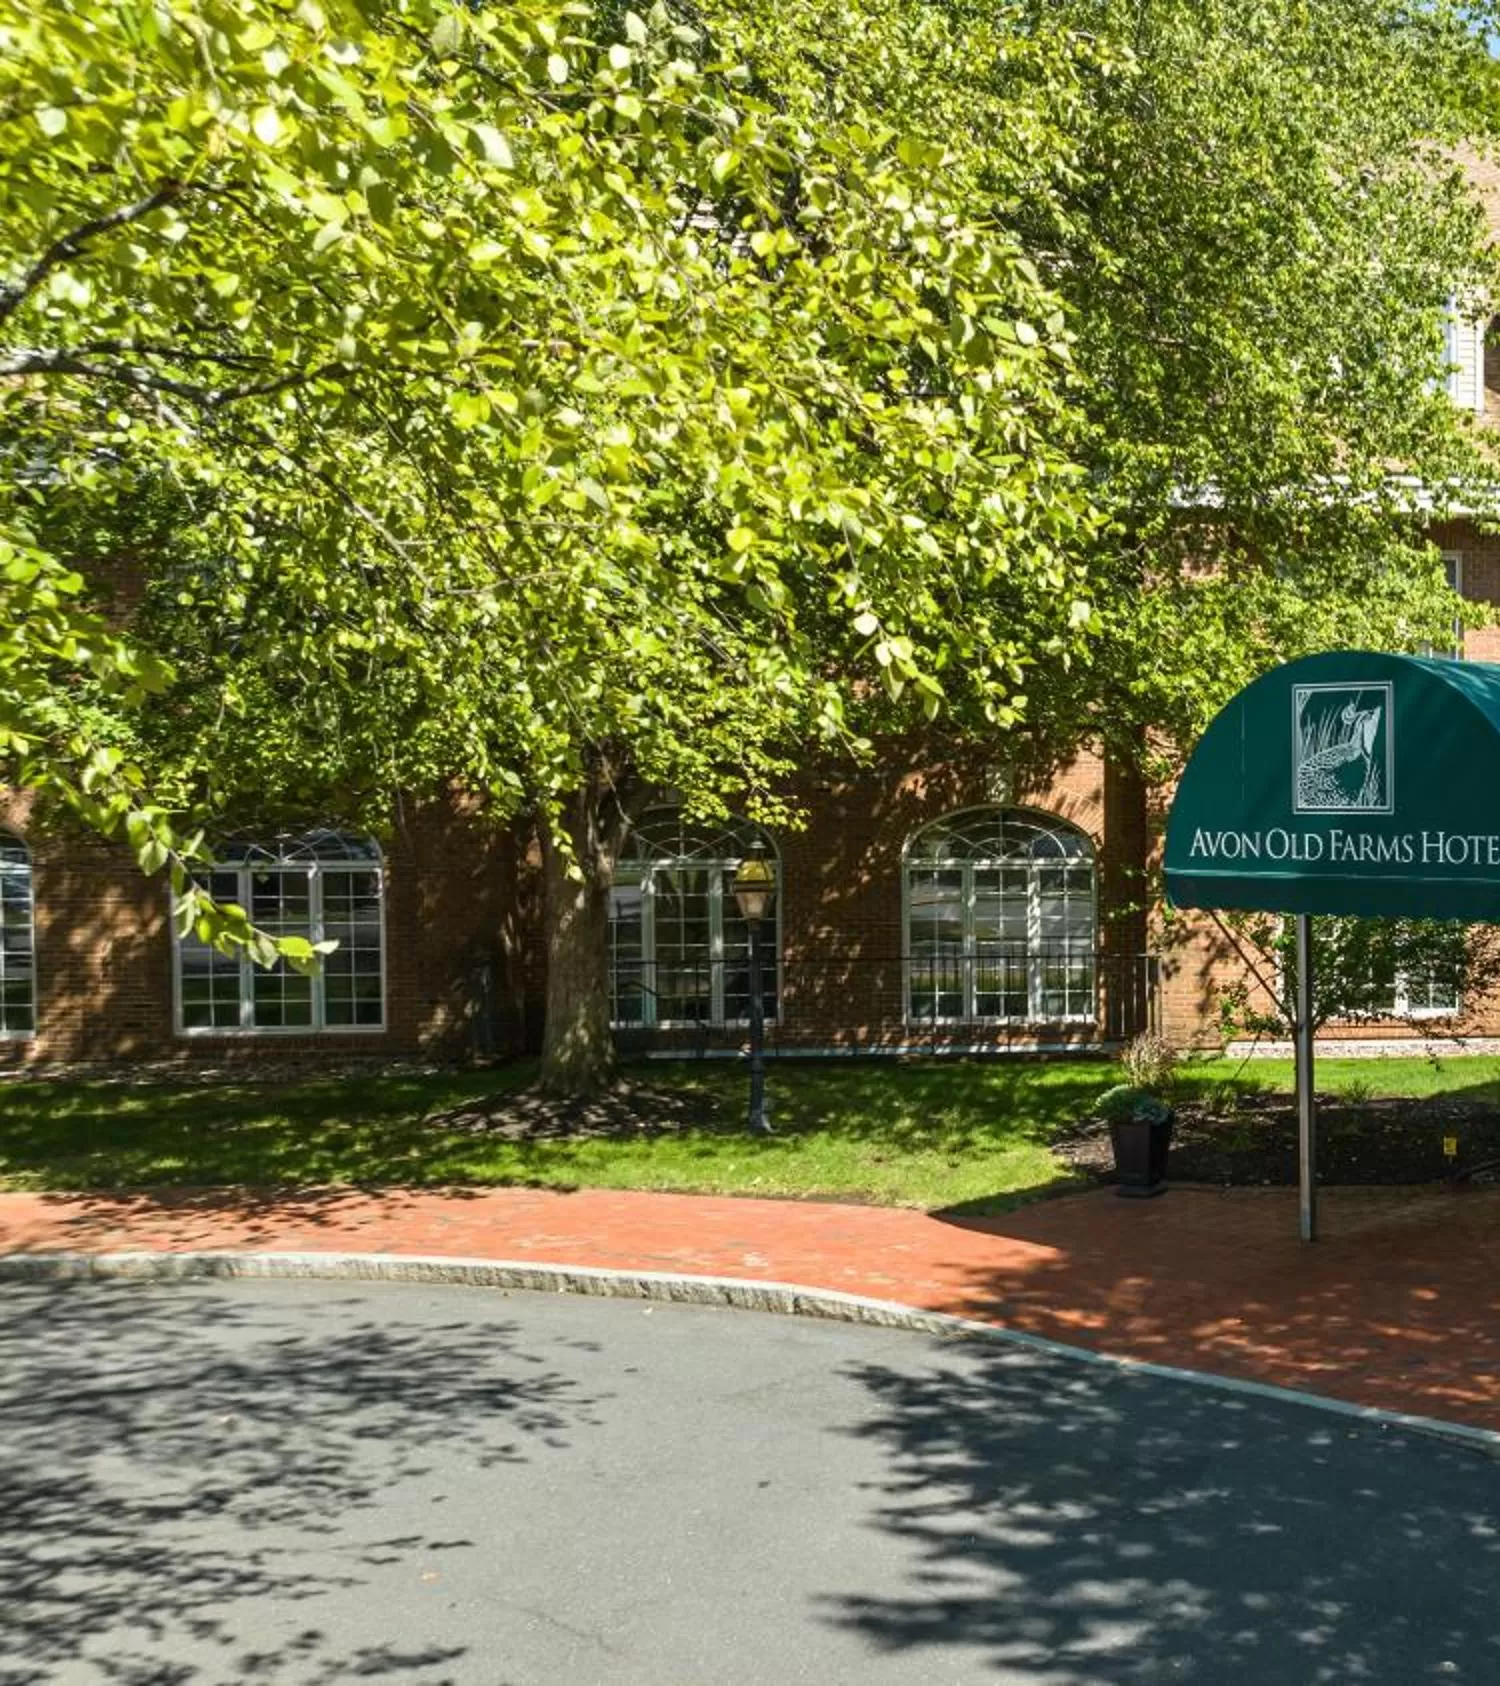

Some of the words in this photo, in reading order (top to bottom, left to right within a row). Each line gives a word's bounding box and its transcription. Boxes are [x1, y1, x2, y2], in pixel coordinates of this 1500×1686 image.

[1189, 827, 1259, 858] AVON
[1264, 827, 1323, 861] OLD
[1328, 829, 1413, 863] FARMS
